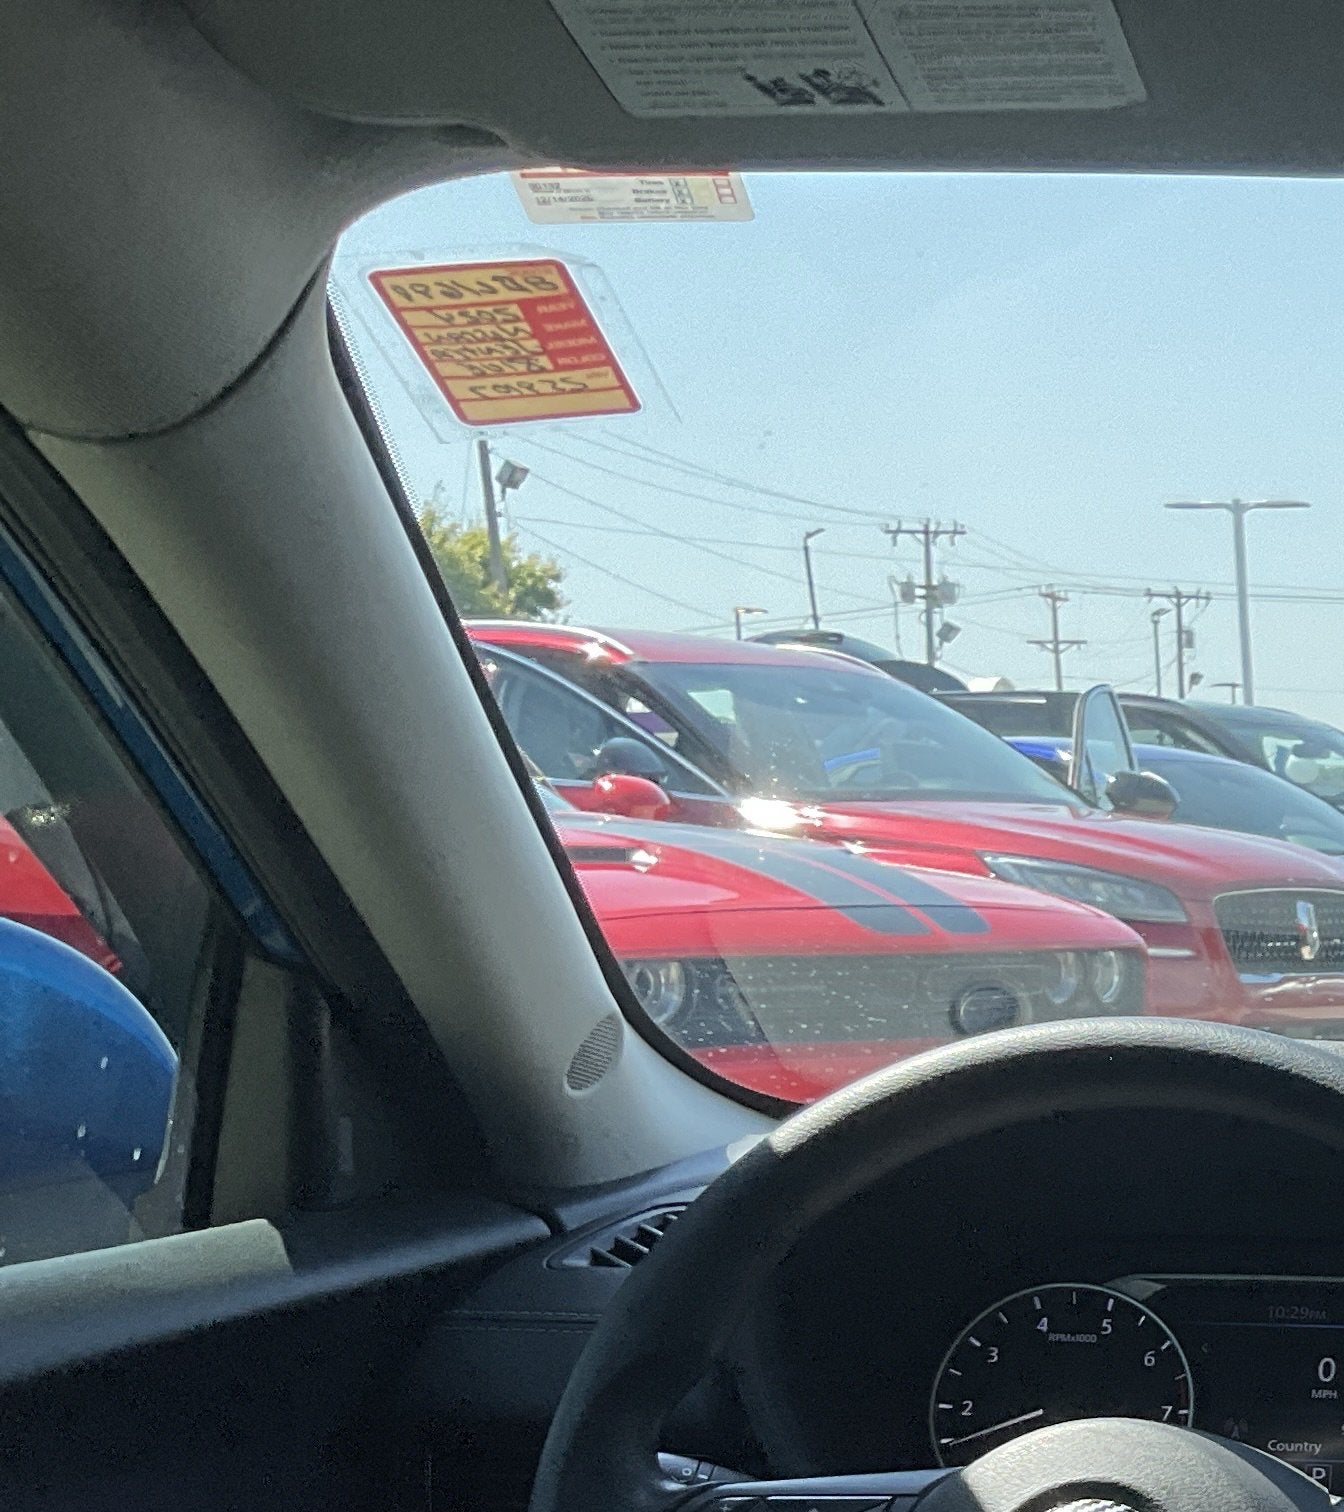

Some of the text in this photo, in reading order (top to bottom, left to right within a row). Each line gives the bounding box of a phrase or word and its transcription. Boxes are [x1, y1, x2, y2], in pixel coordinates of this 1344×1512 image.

[1036, 1317, 1048, 1332] 4
[1101, 1319, 1112, 1335] 5
[988, 1347, 999, 1363] 3
[1143, 1351, 1155, 1366] 6
[1318, 1357, 1336, 1382] 0
[1311, 1389, 1338, 1399] MPH
[961, 1401, 972, 1416] 2
[1161, 1406, 1173, 1421] 7
[1268, 1439, 1322, 1454] Country
